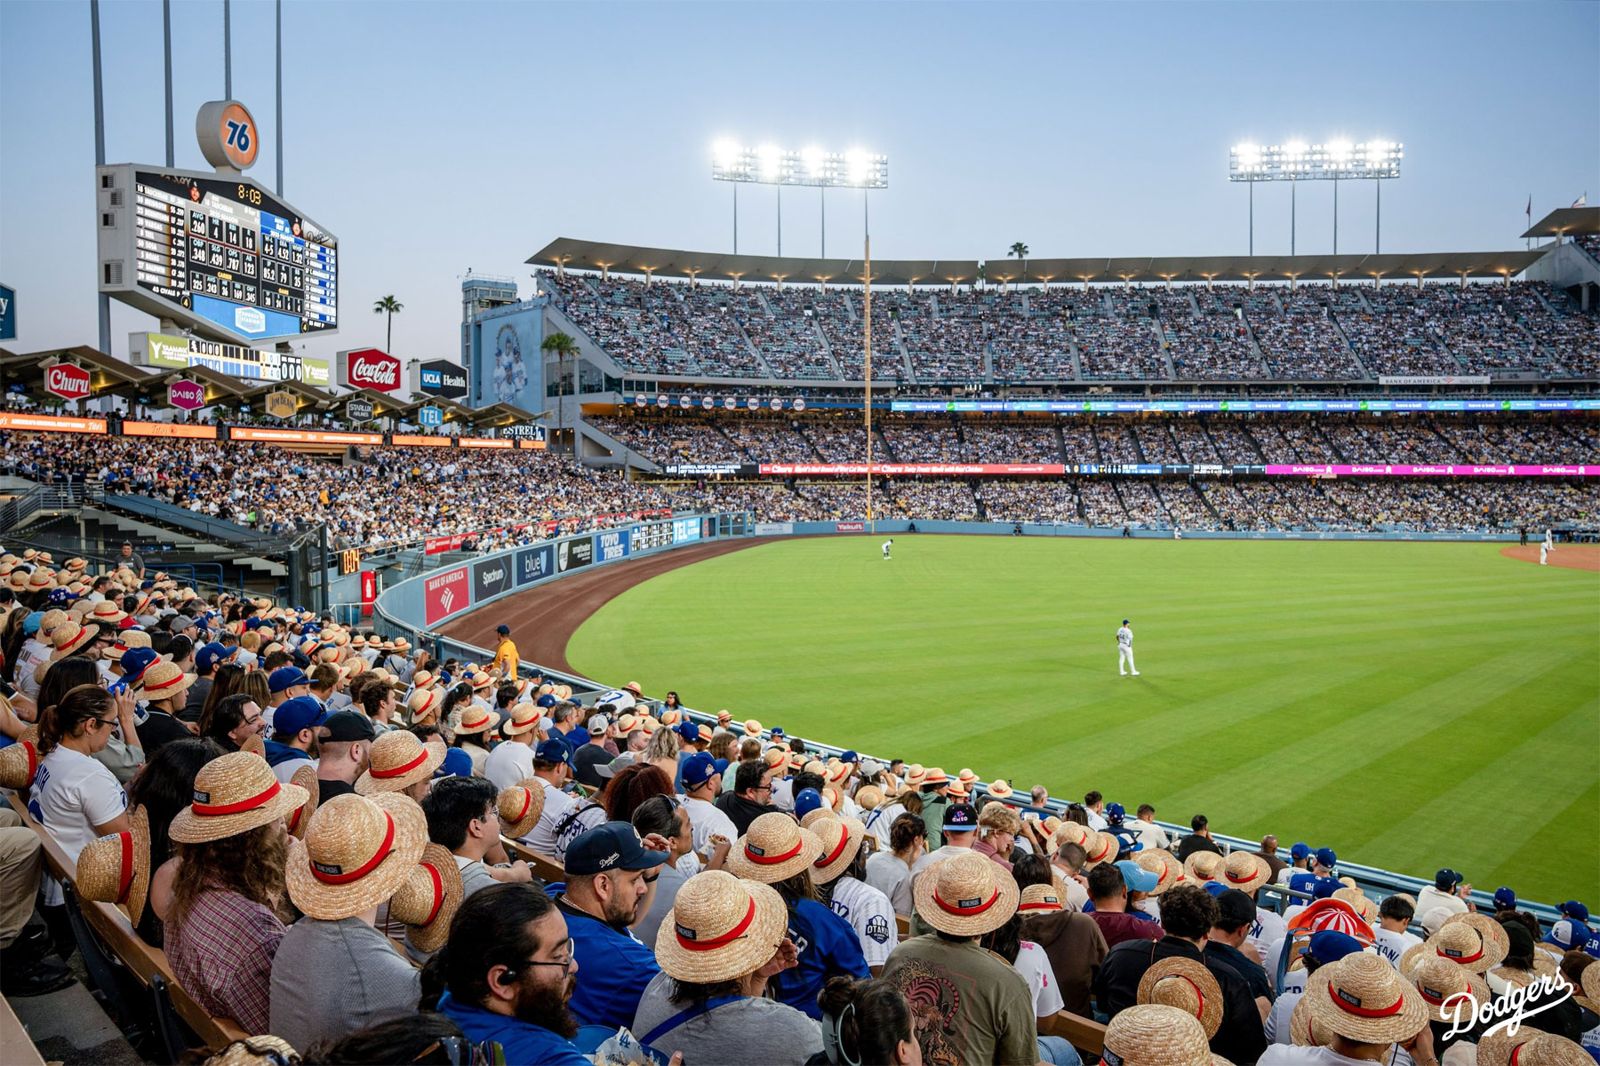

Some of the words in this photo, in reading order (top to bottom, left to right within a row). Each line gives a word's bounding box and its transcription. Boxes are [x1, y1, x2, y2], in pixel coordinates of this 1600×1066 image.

[227, 121, 250, 151] 76
[238, 185, 262, 205] 8:03
[192, 212, 204, 220] AVG
[192, 220, 204, 234] .260
[214, 227, 218, 238] 4
[229, 232, 236, 244] 14
[246, 237, 252, 249] 18
[192, 248, 206, 262] .348
[210, 254, 222, 266] .439
[244, 262, 254, 275] 123
[278, 248, 288, 260] 4.52
[280, 272, 287, 284] 79
[282, 362, 288, 379] 0
[290, 364, 295, 380] 0
[296, 365, 302, 381] 0
[352, 358, 398, 384] Coca-Cola
[50, 370, 89, 393] Churu
[423, 374, 440, 384] UCLA
[443, 374, 466, 388] Health
[172, 390, 194, 400] DAISO
[350, 404, 372, 412] STARLUX
[422, 410, 440, 424] TEL
[674, 521, 687, 540] TEL
[600, 533, 619, 548] TOYO
[604, 544, 624, 560] TIRES
[343, 550, 360, 574] 0:04
[525, 554, 540, 572] blue
[429, 580, 440, 591] BANK
[441, 576, 446, 586] OF
[446, 570, 464, 584] AMERICA
[482, 569, 504, 588] Spectrum
[600, 852, 620, 868] Dodgers
[1377, 943, 1400, 962] TANI
